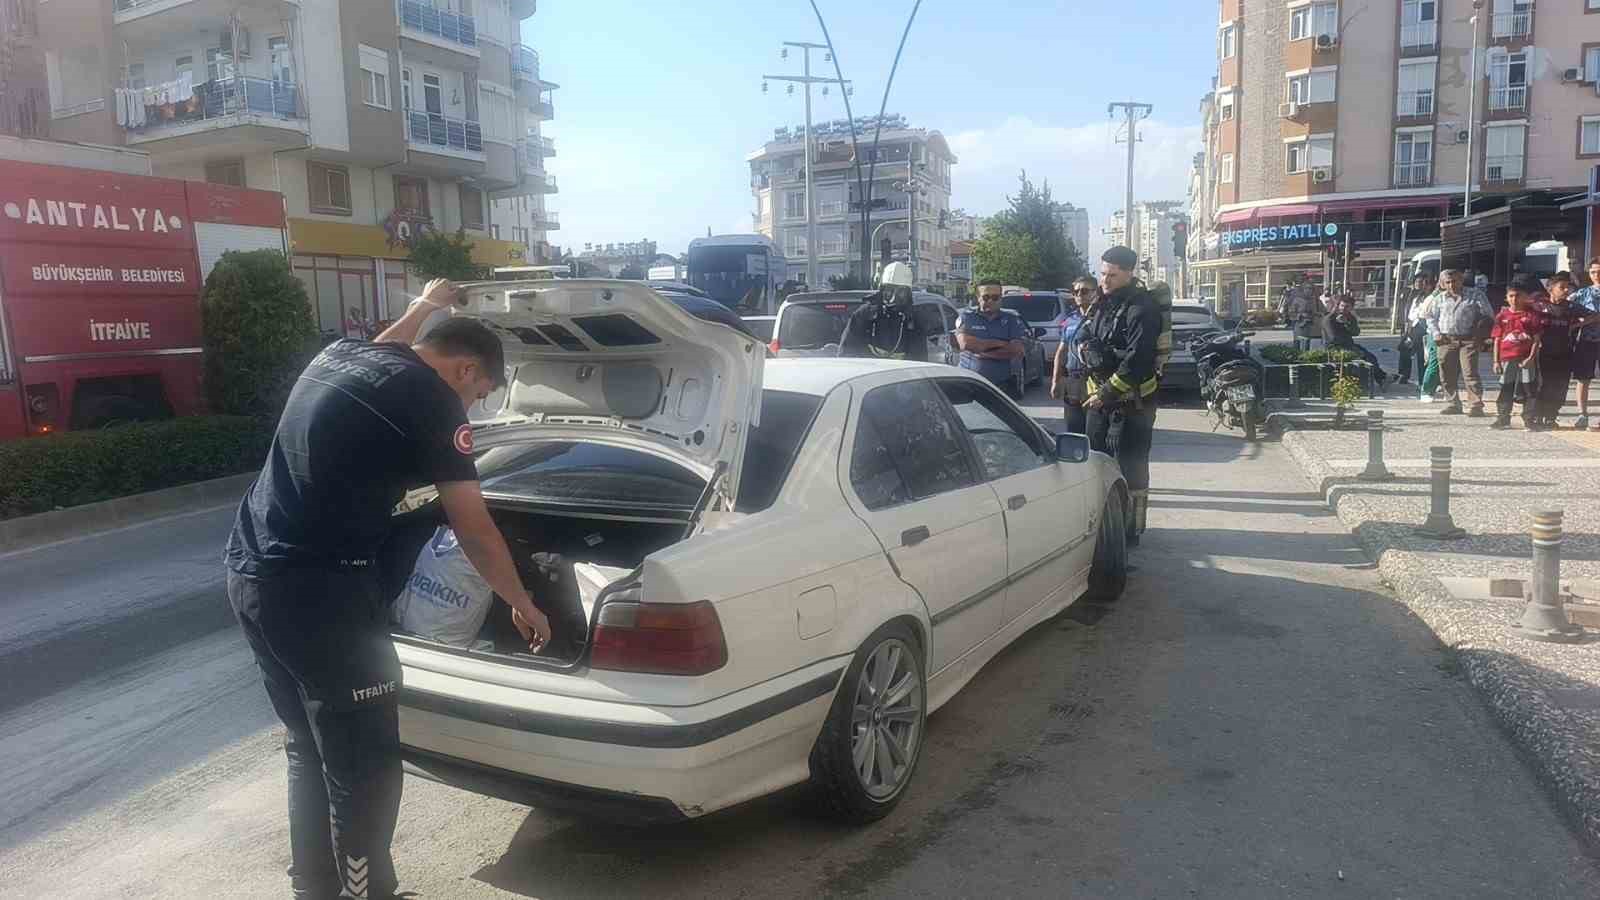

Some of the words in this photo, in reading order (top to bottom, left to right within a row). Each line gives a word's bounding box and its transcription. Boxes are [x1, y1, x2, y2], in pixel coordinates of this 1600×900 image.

[26, 199, 169, 233] ANTALYA
[1222, 226, 1278, 244] EKSPRES
[32, 263, 113, 284] BÜYÜKŞEHİR
[121, 267, 185, 282] BELEDİYESİ
[90, 319, 151, 341] İTFAİYE
